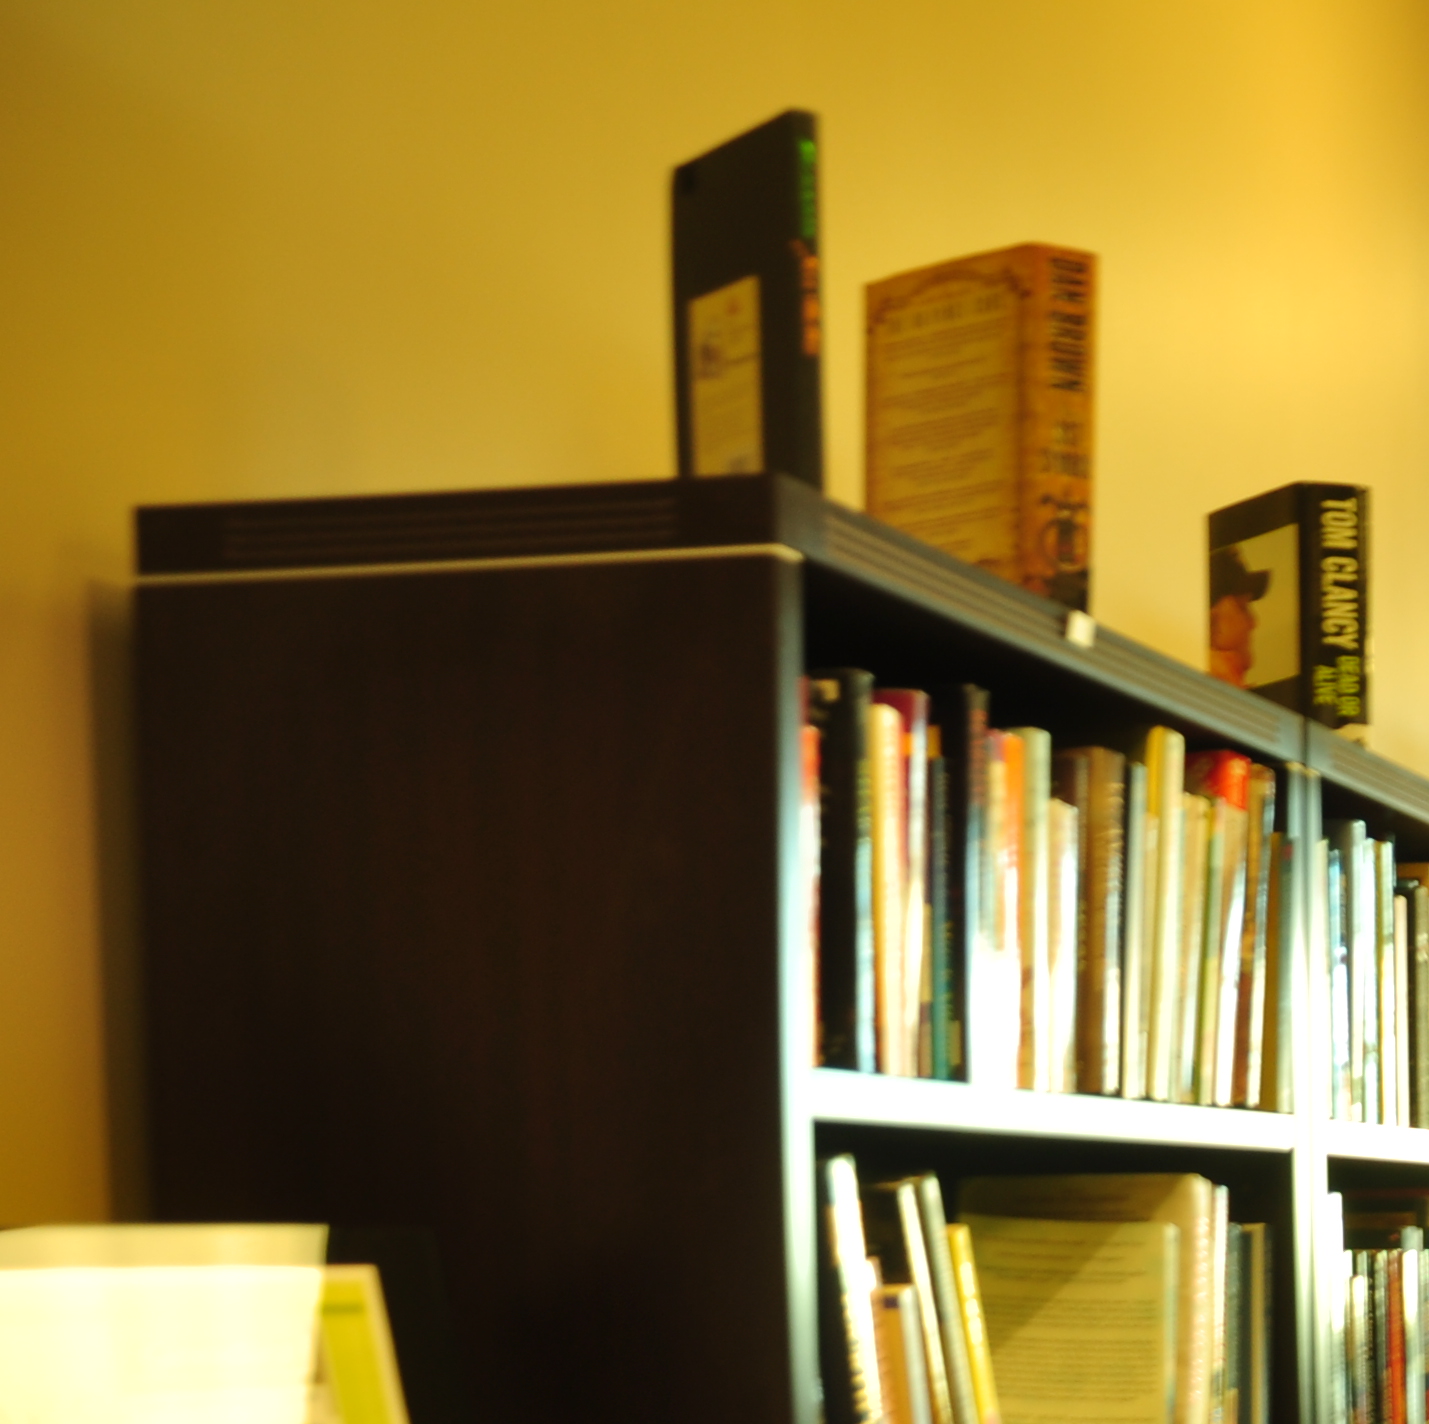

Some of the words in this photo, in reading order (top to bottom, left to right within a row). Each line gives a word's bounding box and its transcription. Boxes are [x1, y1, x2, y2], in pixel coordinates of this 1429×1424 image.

[1047, 257, 1089, 302] DAN
[1047, 310, 1088, 393] BROWN
[1319, 497, 1358, 550] TOM
[1320, 555, 1360, 650] CLANCY
[1312, 664, 1337, 706] ALIVE
[1335, 655, 1361, 694] DEAD
